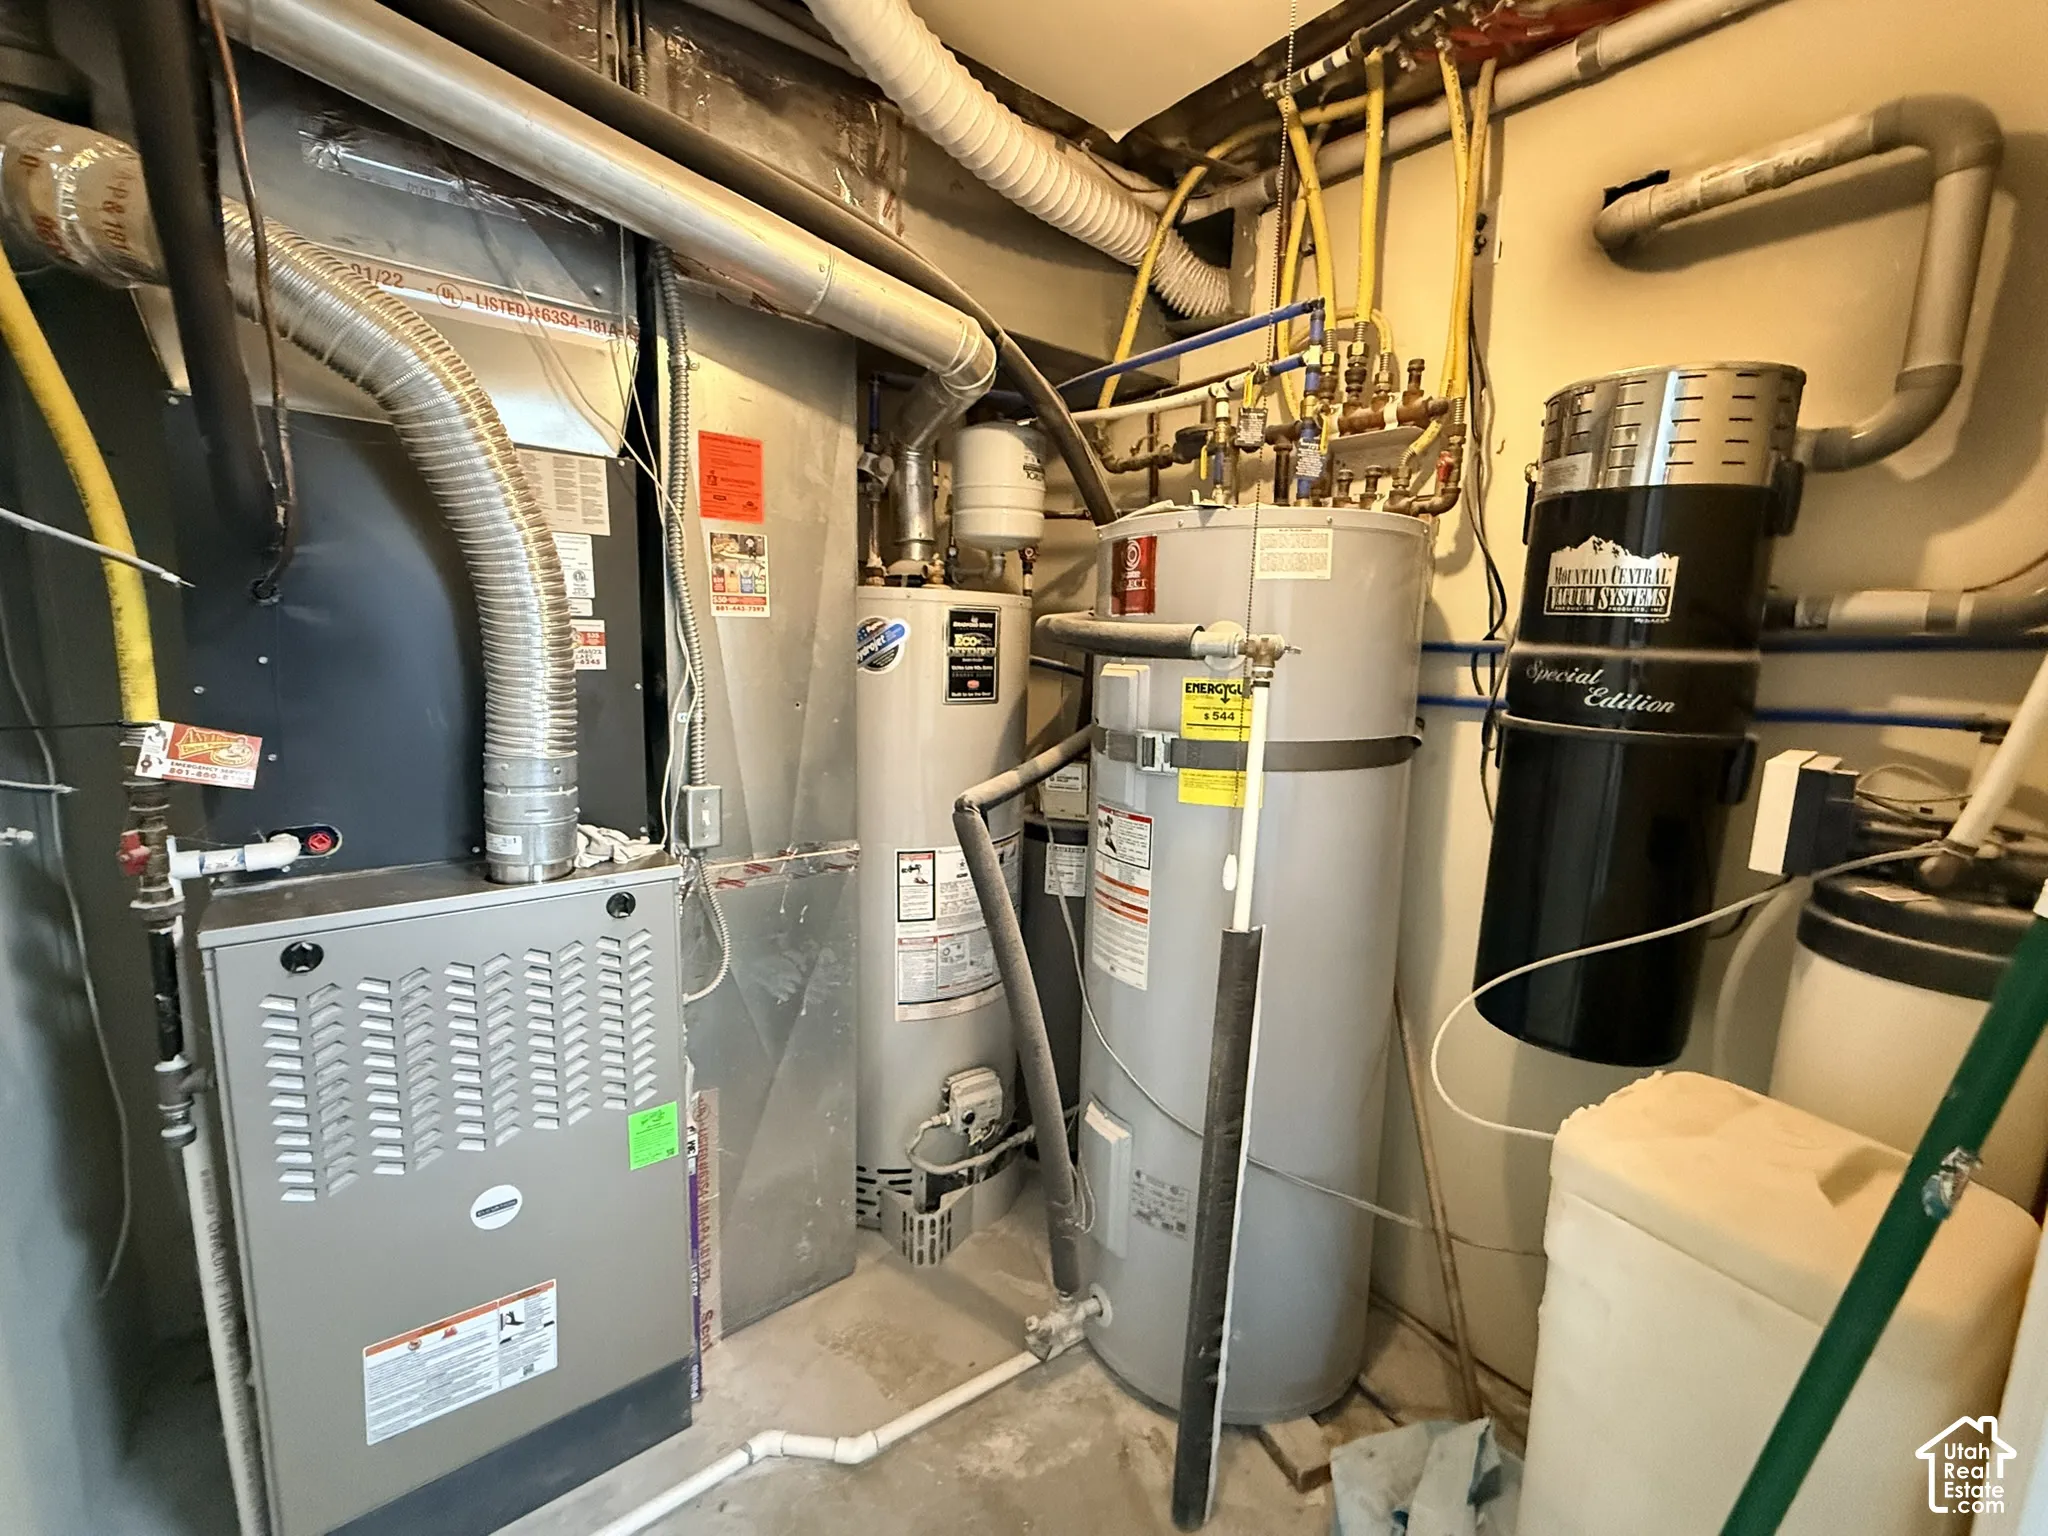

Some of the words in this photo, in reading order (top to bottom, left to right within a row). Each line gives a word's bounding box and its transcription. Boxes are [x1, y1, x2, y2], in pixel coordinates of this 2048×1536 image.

[475, 293, 526, 316] LISTED
[1554, 567, 1607, 585] MOUNTAIN
[1611, 565, 1669, 585] CENTRAL
[1551, 587, 1596, 609] VACUUM
[1598, 587, 1668, 610] SYSTEMS
[1526, 659, 1604, 684] Special
[1584, 686, 1675, 713] Edition
[1204, 712, 1210, 721] $
[1212, 711, 1236, 721] 544
[170, 761, 219, 772] EMERGENCY
[687, 1139, 697, 1155] 3M
